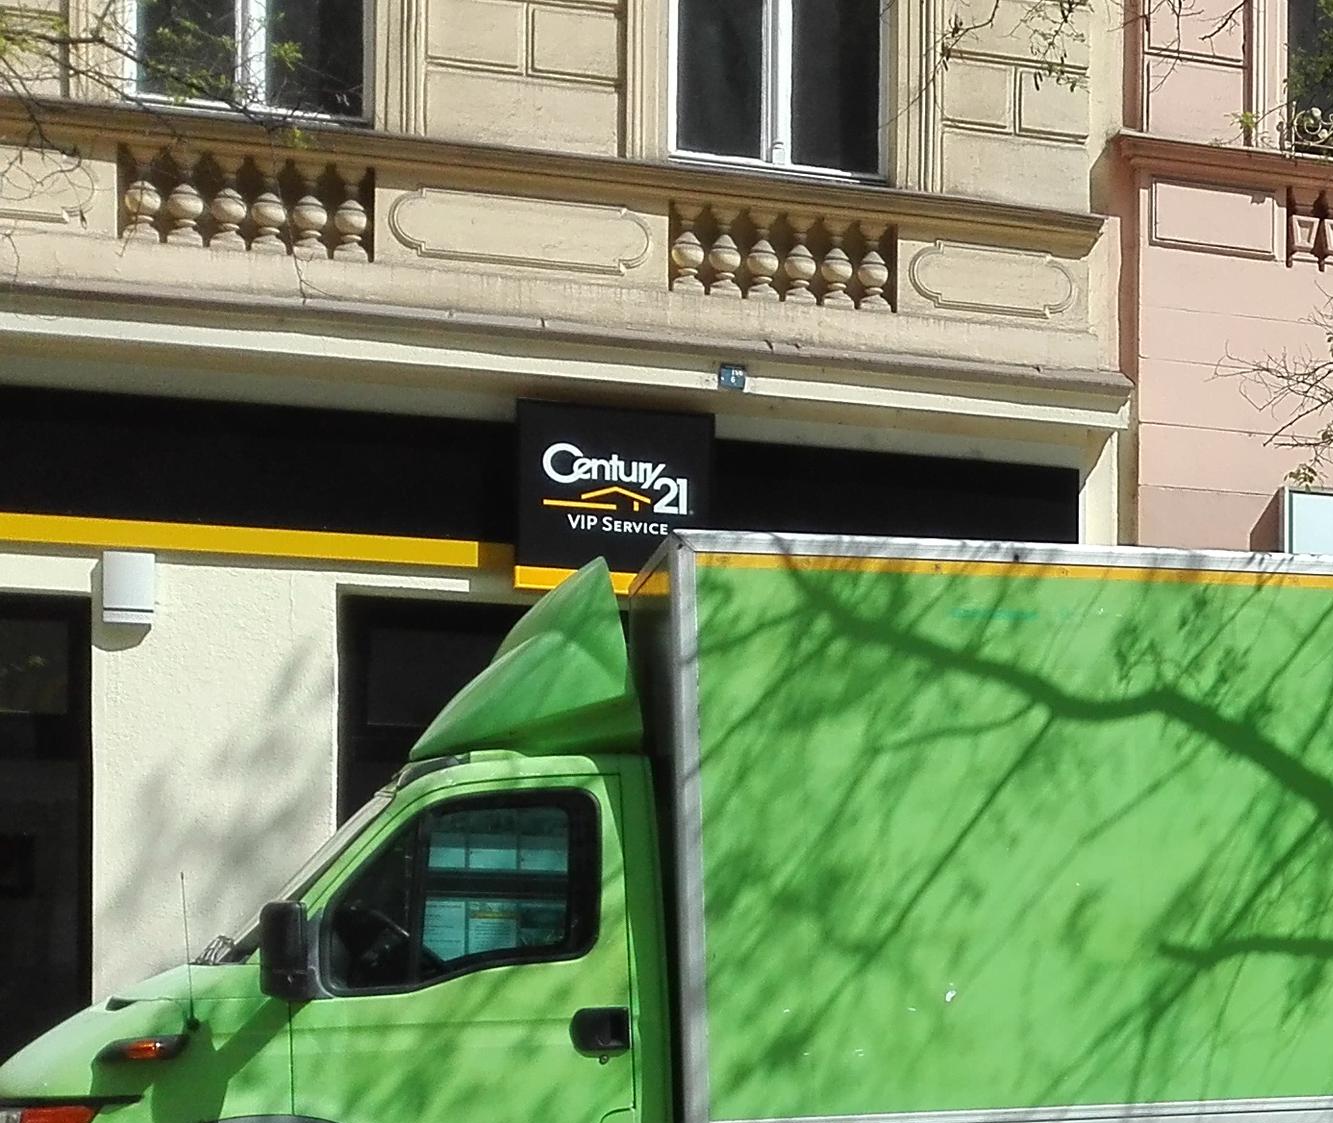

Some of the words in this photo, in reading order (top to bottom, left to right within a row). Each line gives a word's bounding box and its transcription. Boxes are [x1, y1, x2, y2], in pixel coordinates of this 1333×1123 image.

[543, 442, 666, 489] Century
[653, 477, 688, 515] 21
[567, 513, 598, 530] VIP
